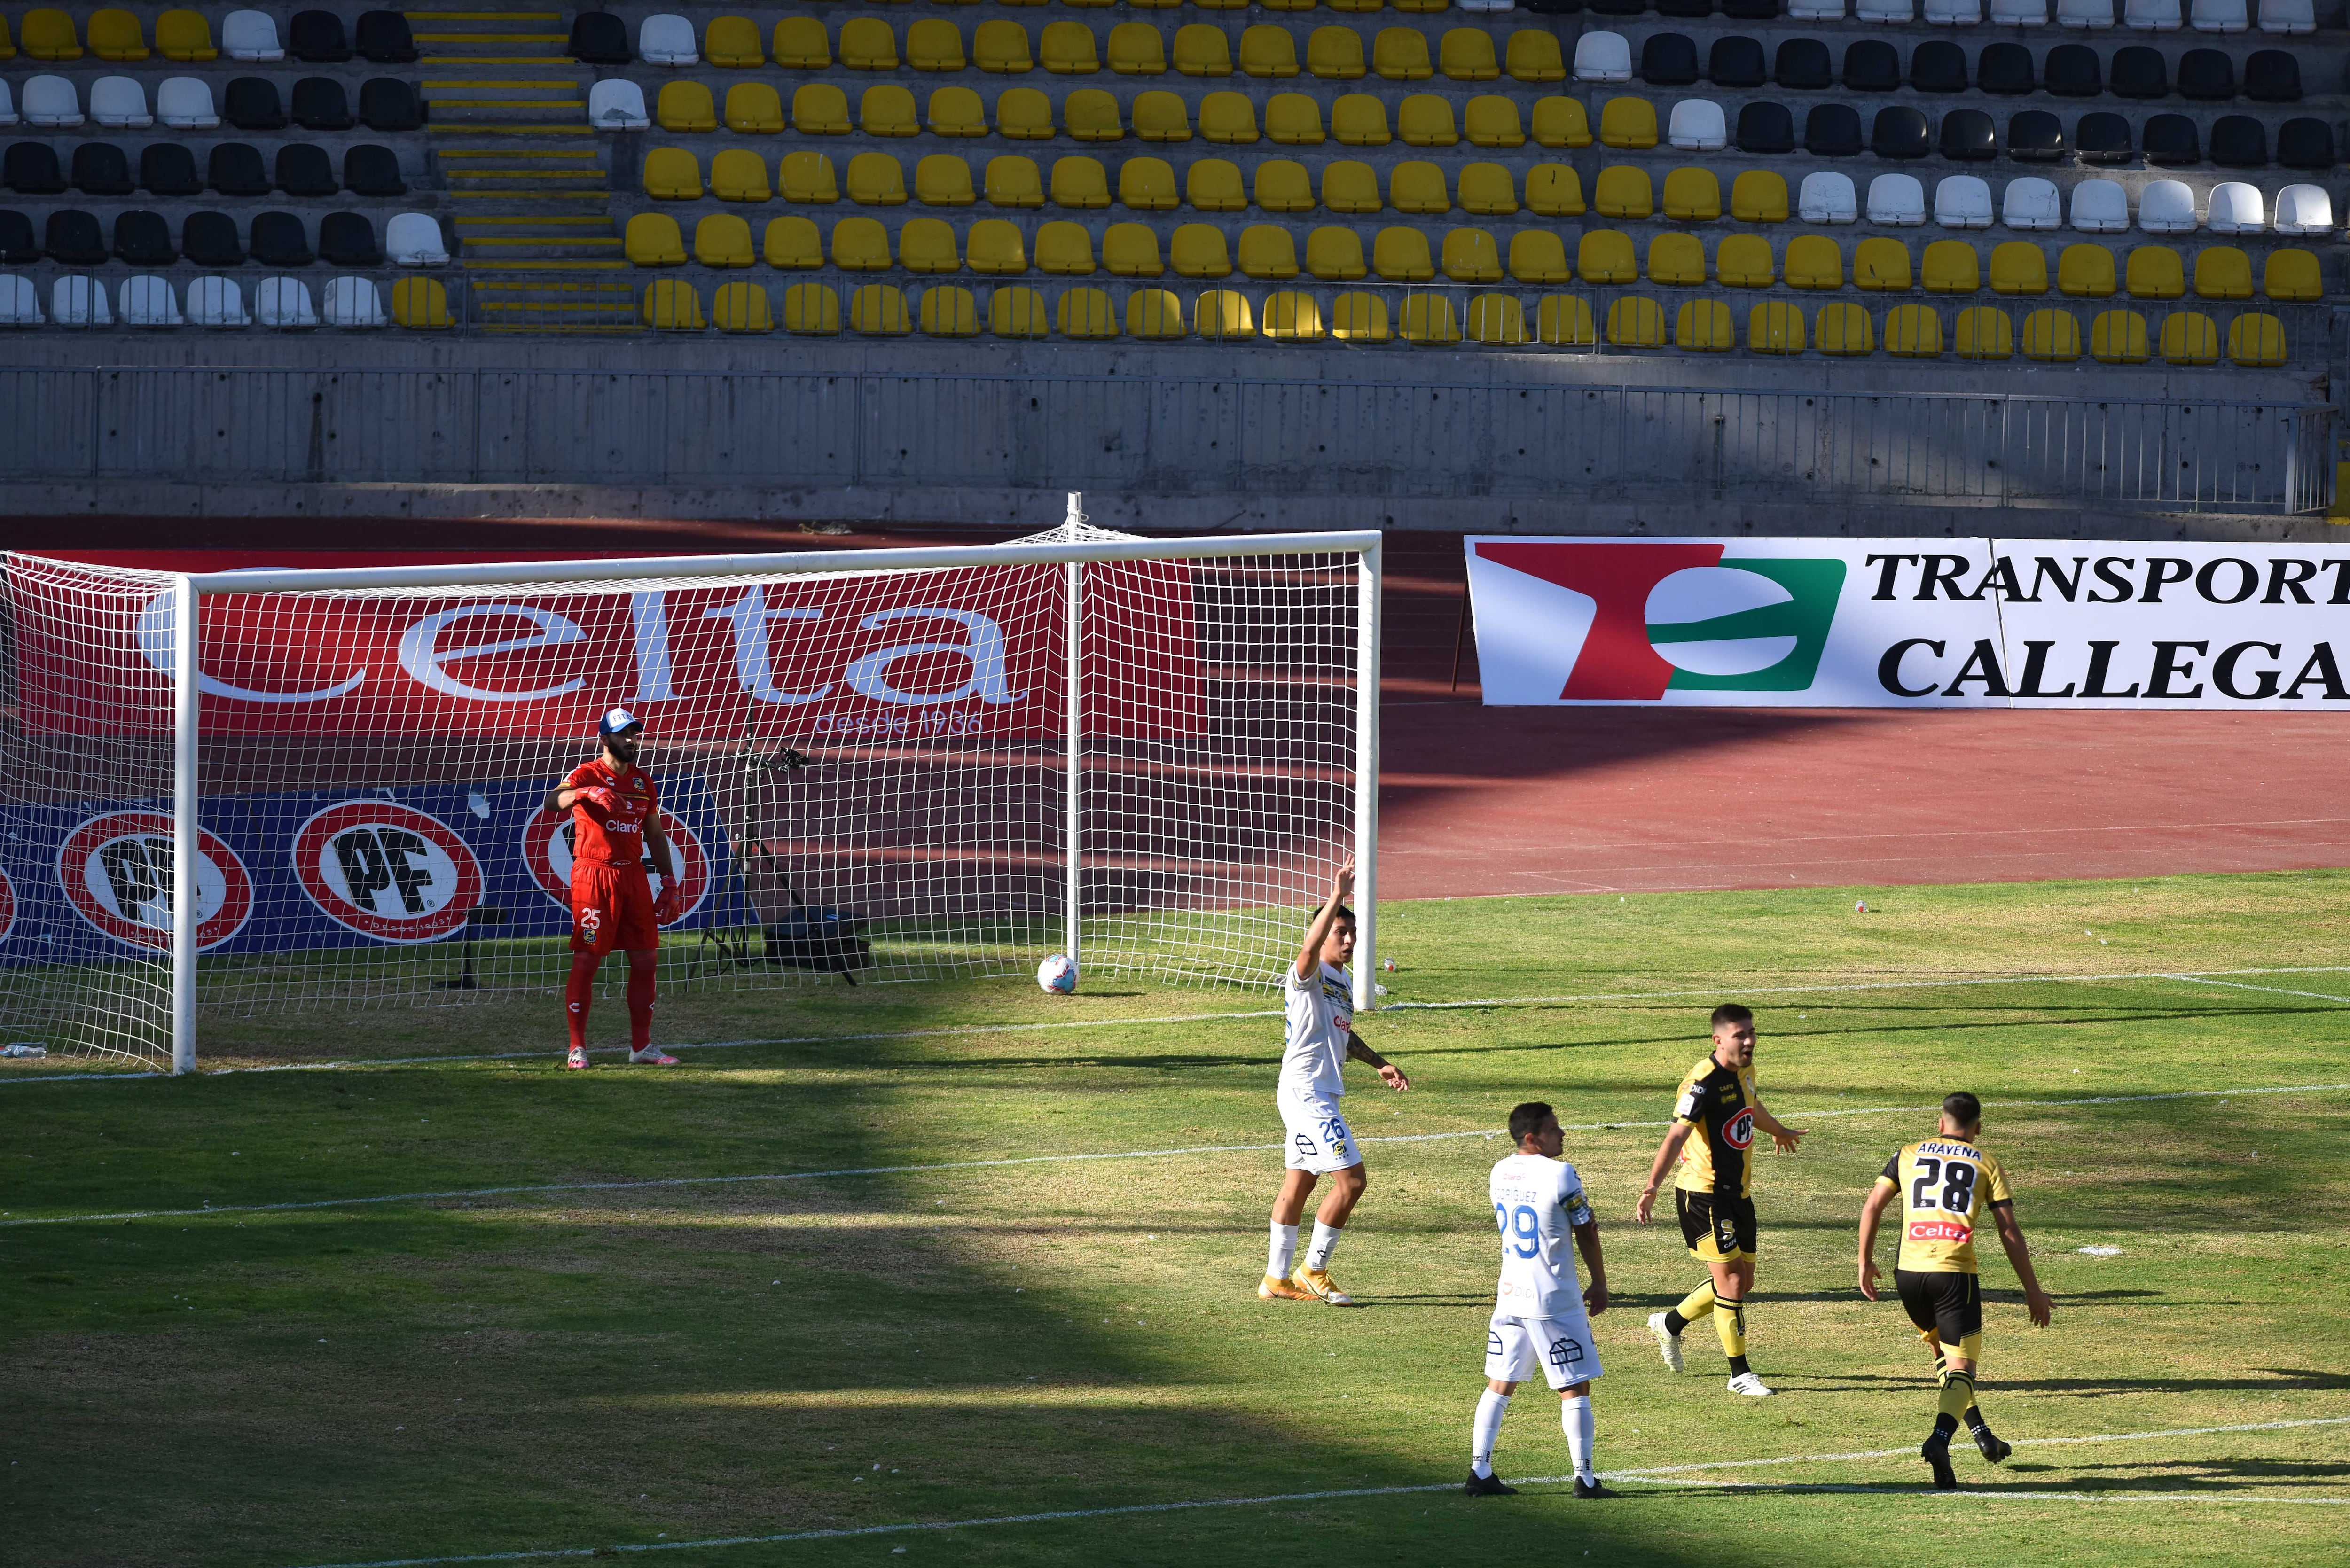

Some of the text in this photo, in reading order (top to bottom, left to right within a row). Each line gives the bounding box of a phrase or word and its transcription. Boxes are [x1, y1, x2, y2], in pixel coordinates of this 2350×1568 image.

[136, 567, 1028, 705] Celta
[1877, 638, 2350, 700] CALLEGA
[816, 710, 983, 734] desde 1936
[606, 819, 638, 833] Claro
[333, 828, 433, 914] PF
[373, 922, 415, 932] DESDE
[581, 907, 601, 930] 25
[1691, 1084, 1707, 1095] DiDi
[1319, 1118, 1345, 1143] 26
[1737, 1114, 1752, 1142] PF
[1917, 1143, 1982, 1161] ARAVENA
[1912, 1156, 1976, 1213] 28
[1911, 1225, 1968, 1240] Celta
